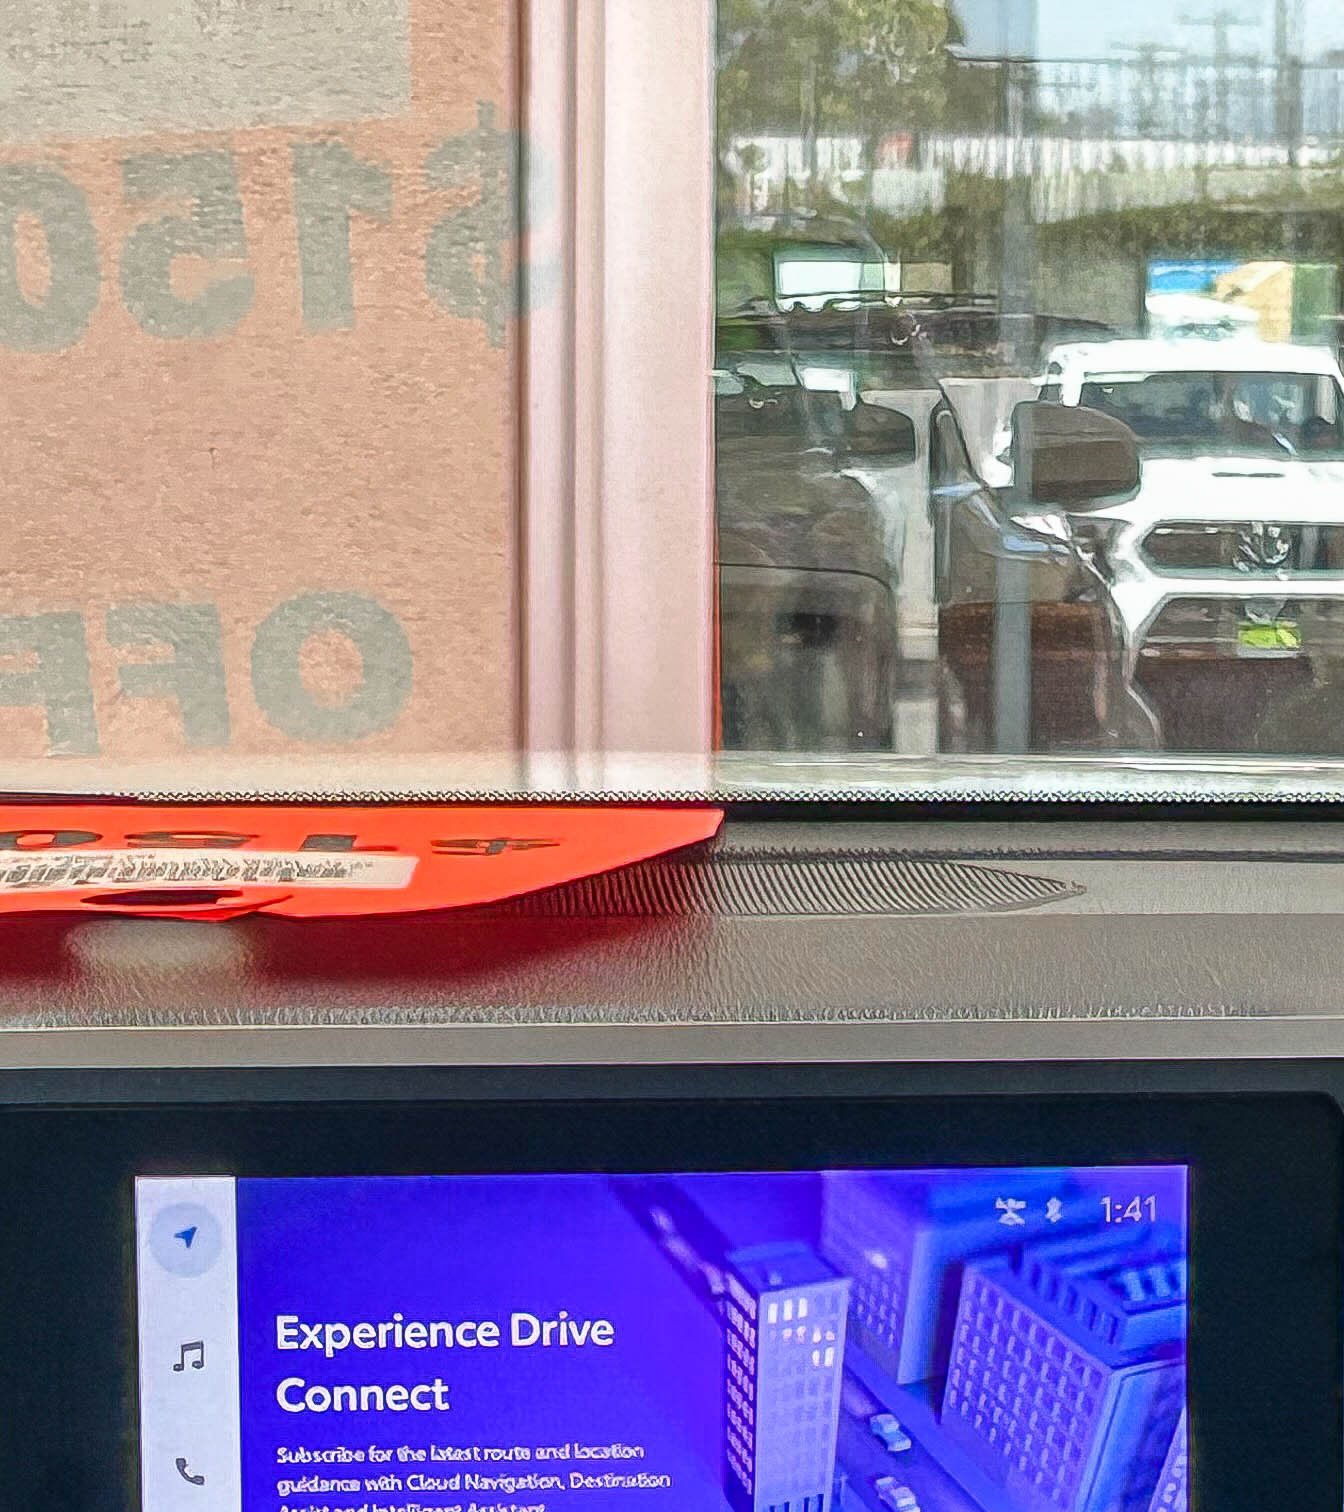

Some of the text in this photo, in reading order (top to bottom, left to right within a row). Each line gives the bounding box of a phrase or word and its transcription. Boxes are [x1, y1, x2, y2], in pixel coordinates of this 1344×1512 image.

[1100, 1195, 1157, 1223] 1:41
[276, 1311, 615, 1357] Experience Drive
[276, 1376, 450, 1413] Connect
[276, 1442, 645, 1464] Subscribe for the latest route and location
[276, 1476, 361, 1497] guidance
[365, 1474, 403, 1492] with
[406, 1474, 460, 1491] Cloud
[569, 1471, 672, 1489] Destination
